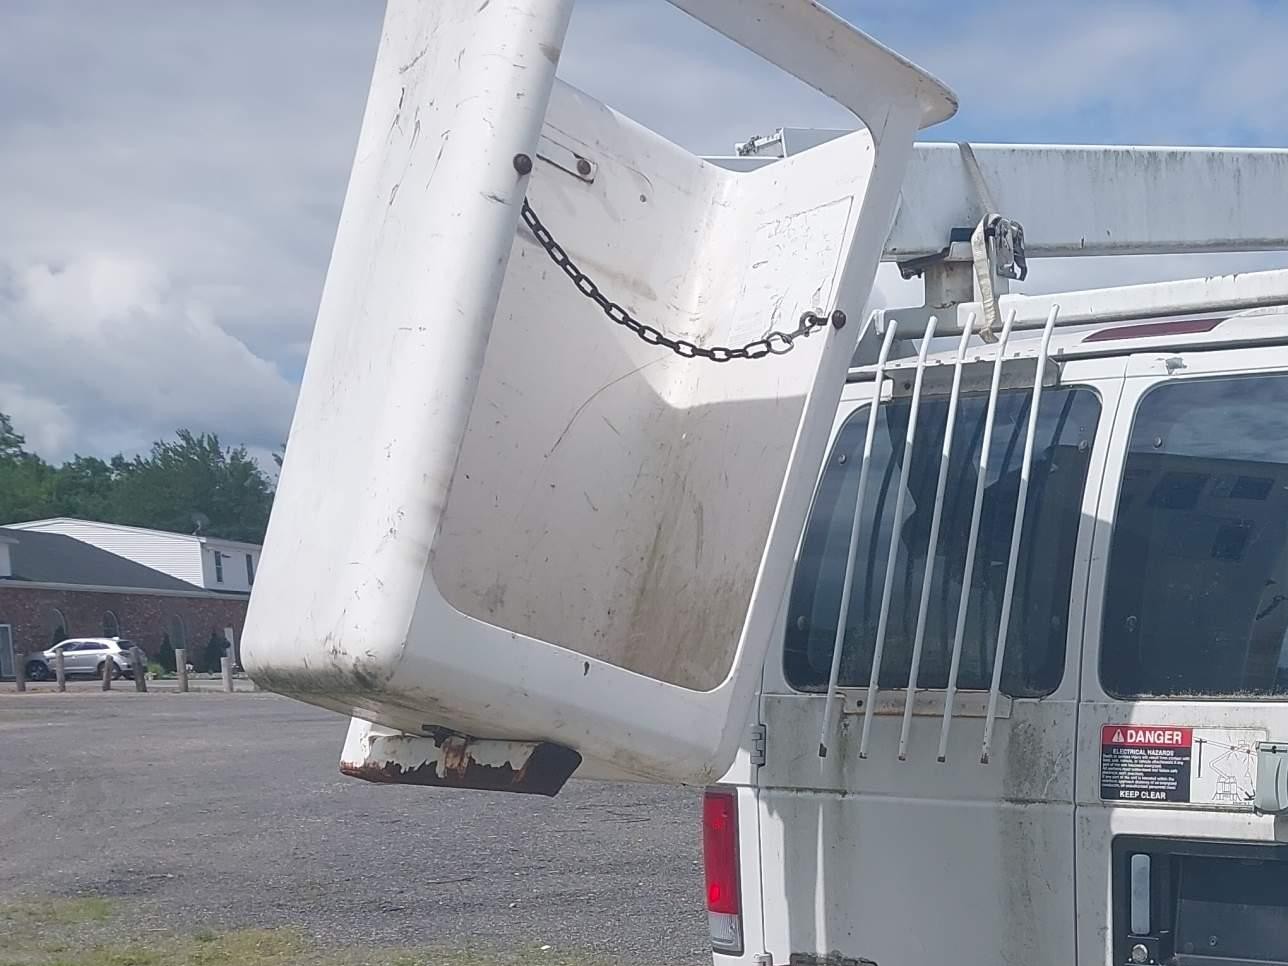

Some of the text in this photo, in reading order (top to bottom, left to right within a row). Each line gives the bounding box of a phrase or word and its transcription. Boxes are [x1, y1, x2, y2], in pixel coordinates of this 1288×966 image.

[1127, 730, 1182, 744] DANGER
[1113, 748, 1175, 757] ELECTRICAL HAZARDS
[1120, 790, 1166, 799] KEEP CLEAR
